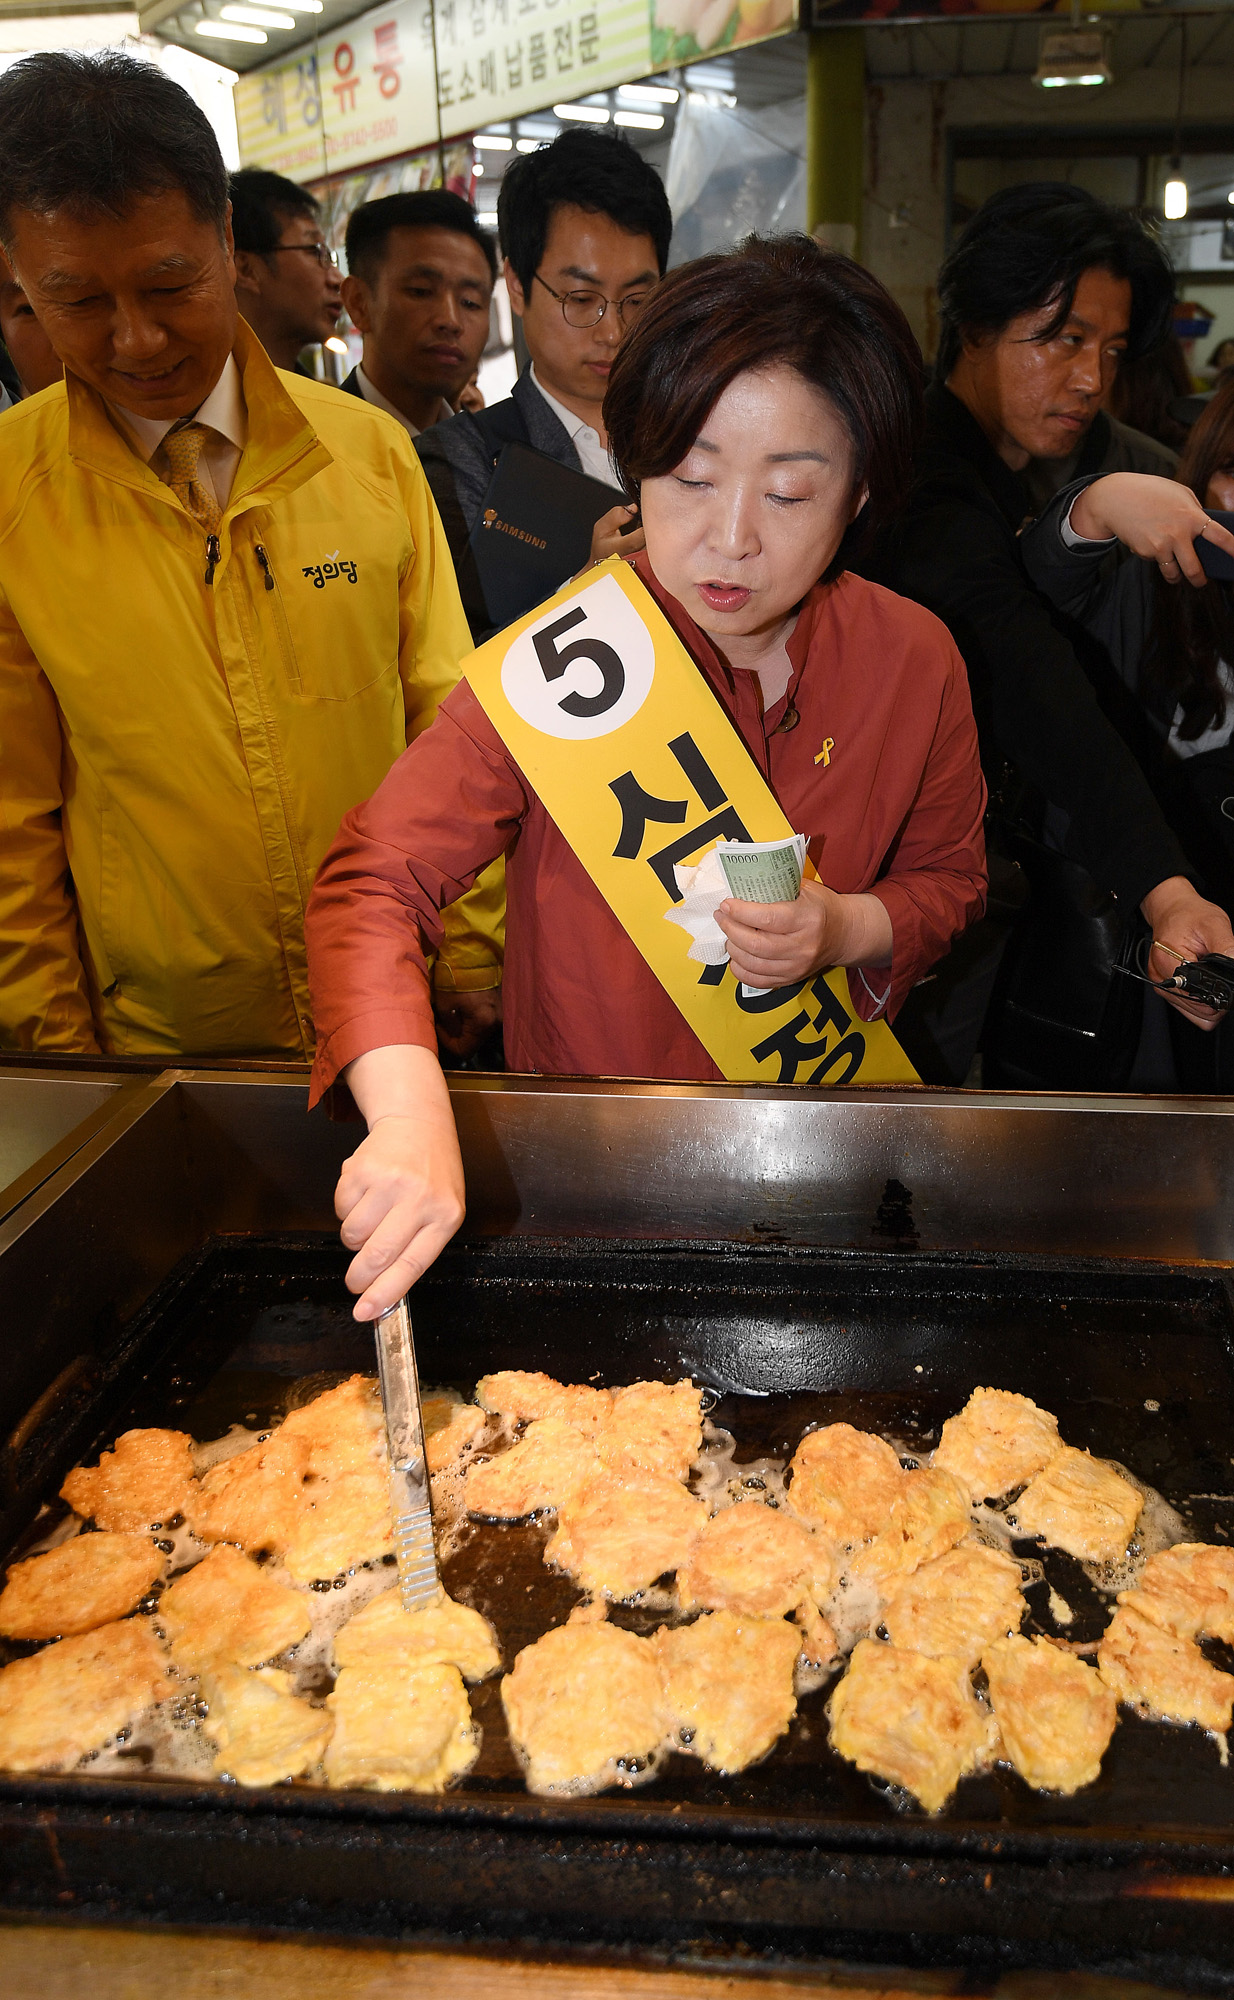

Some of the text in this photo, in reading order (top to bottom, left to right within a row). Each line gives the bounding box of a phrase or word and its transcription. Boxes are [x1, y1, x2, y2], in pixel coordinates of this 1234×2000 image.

[495, 519, 547, 550] SAMSUNG
[302, 560, 358, 589] 정의당
[531, 606, 625, 718] 5
[726, 854, 759, 864] 10000
